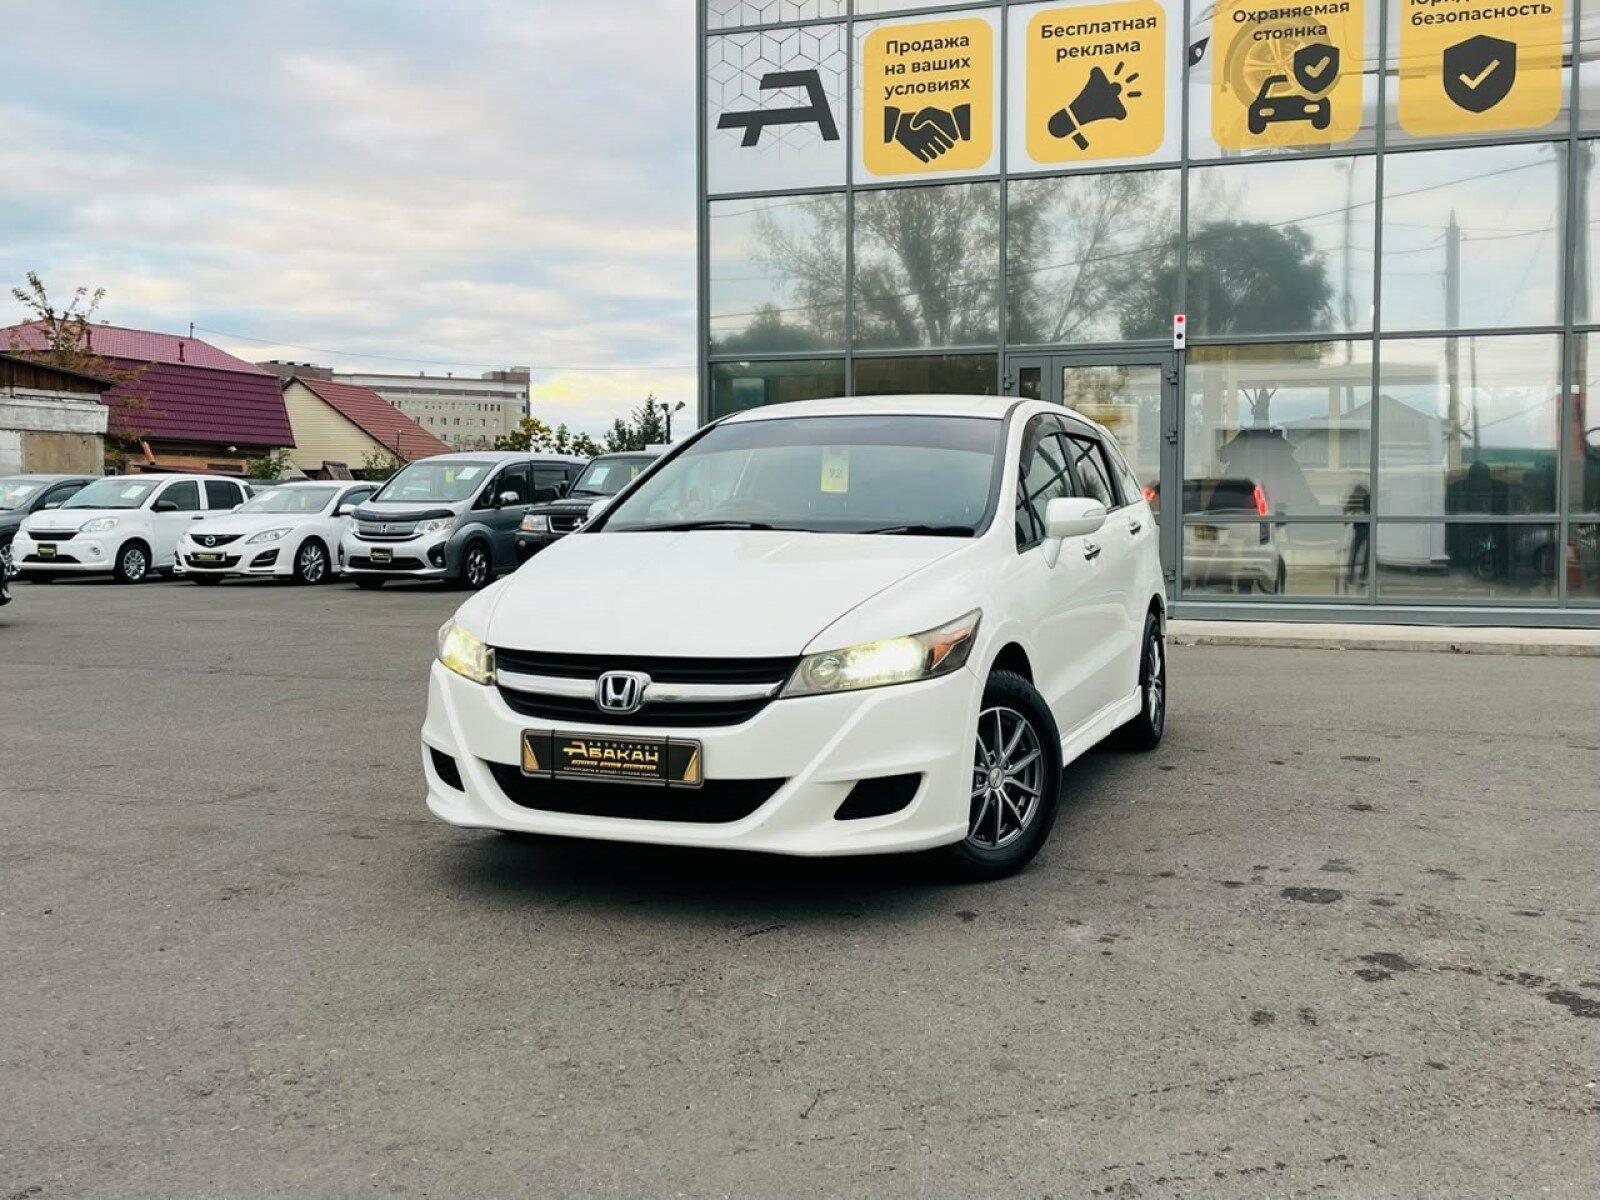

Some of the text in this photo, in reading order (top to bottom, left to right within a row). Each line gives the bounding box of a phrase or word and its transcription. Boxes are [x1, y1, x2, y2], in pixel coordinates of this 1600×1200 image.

[1233, 2, 1350, 24] Охраняемая
[1411, 3, 1552, 26] безопасность
[1041, 17, 1157, 39] Бесплатная
[1253, 25, 1328, 41] стоянка
[886, 35, 970, 56] Продажа
[1056, 41, 1141, 62] реклама
[885, 57, 971, 75] на ваших
[884, 78, 971, 100] условиях
